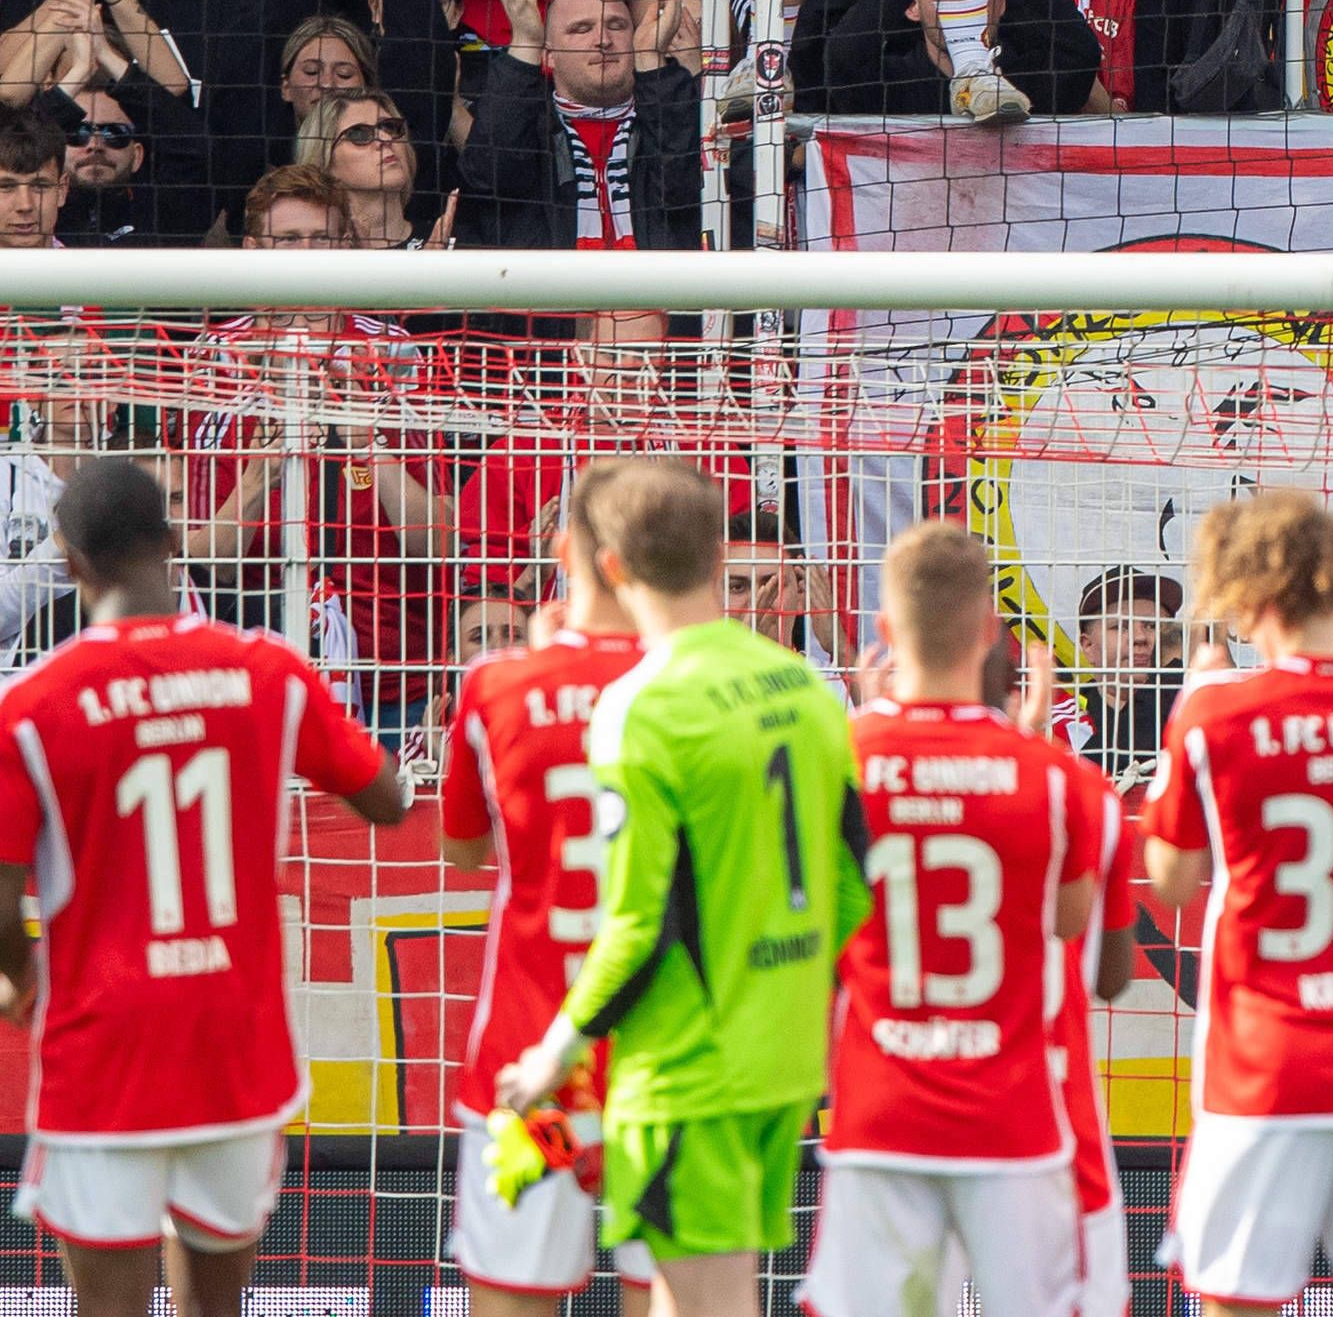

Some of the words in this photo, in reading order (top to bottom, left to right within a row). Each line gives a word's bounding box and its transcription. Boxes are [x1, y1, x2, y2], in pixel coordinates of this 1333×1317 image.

[110, 678, 150, 720] FC
[150, 670, 252, 714] UNION
[1281, 711, 1325, 754] FC
[764, 742, 808, 913] 1
[911, 755, 1018, 795] UNION
[117, 746, 239, 936] 11
[866, 833, 1005, 1009] 13
